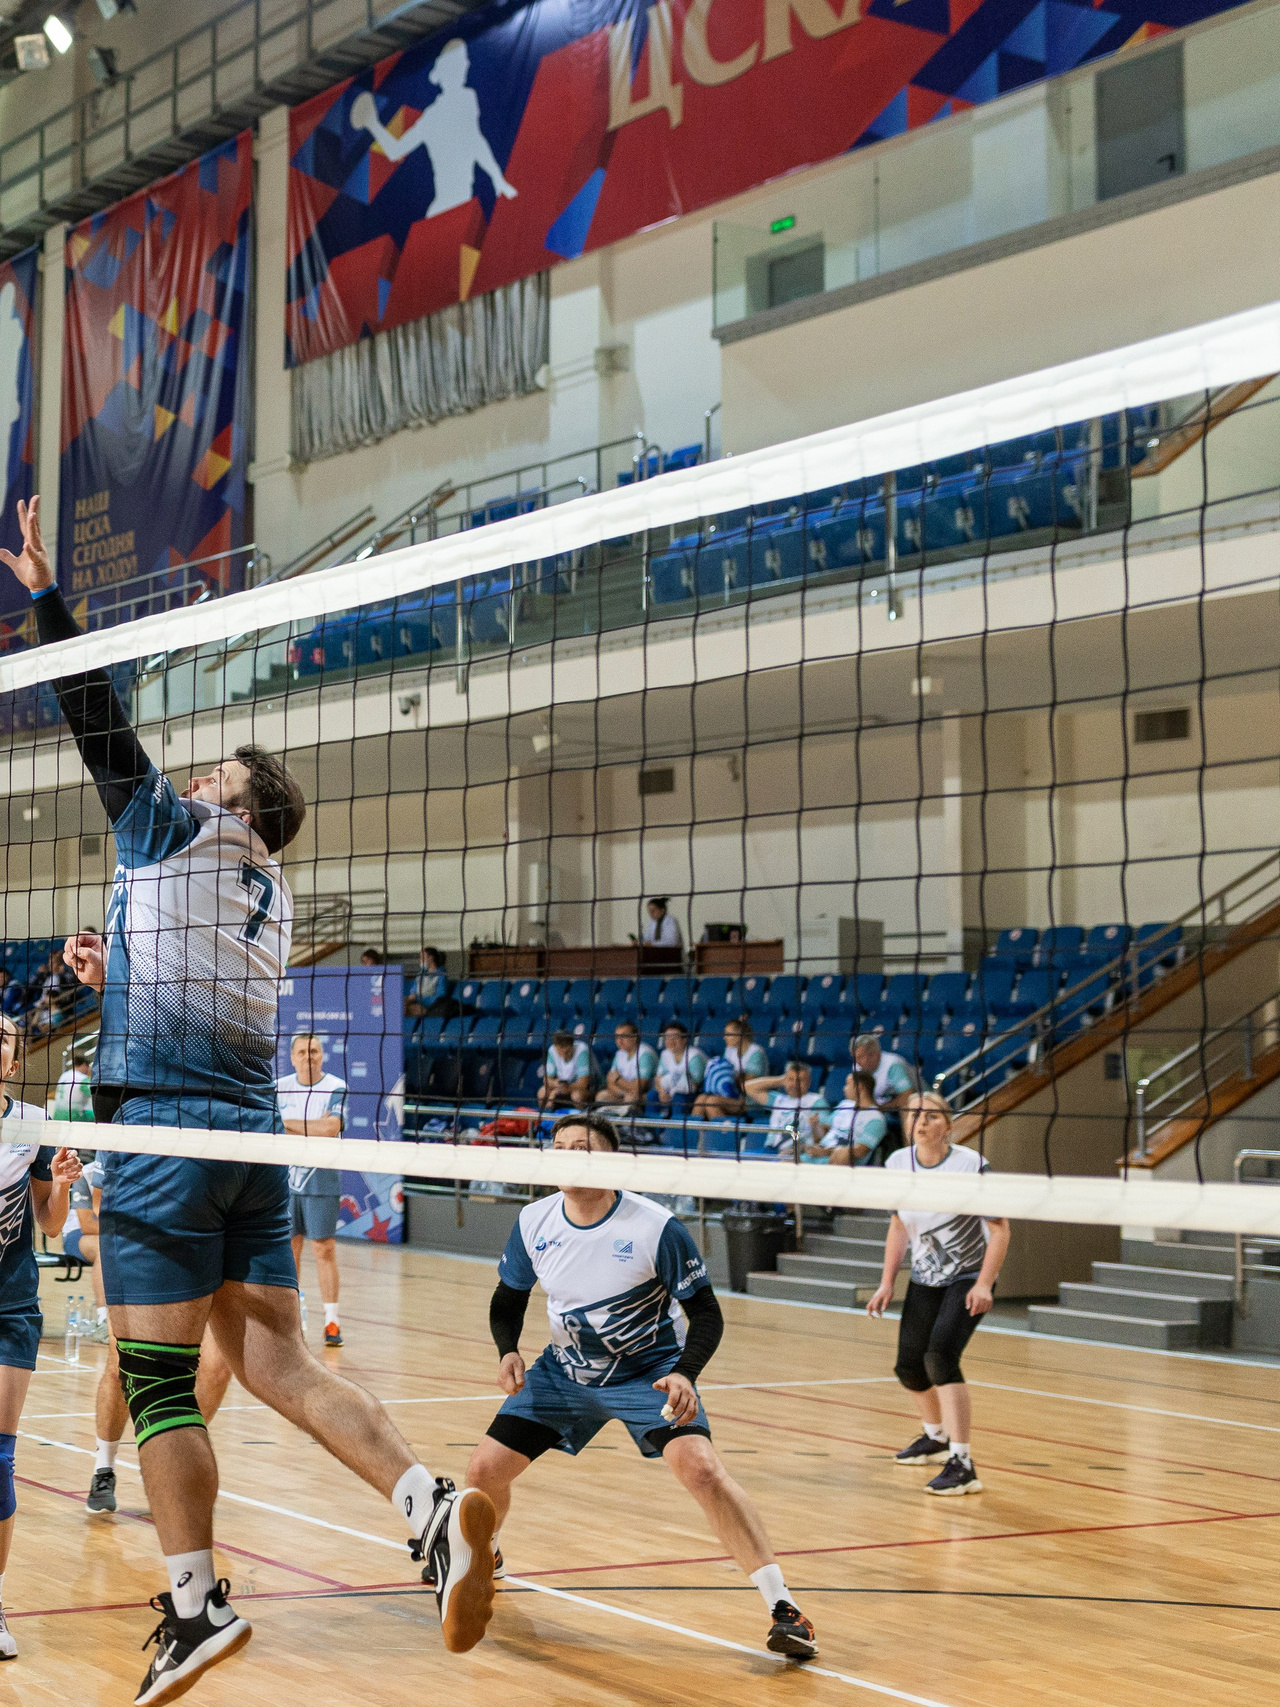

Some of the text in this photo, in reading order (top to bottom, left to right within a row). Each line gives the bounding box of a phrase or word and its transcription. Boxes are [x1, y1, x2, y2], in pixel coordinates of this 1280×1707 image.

[75, 490, 110, 520] НАШ
[74, 514, 111, 544] ЦСКА
[72, 530, 136, 567] СЕГОДНЯ
[72, 568, 94, 591] НА
[236, 855, 276, 947] 7
